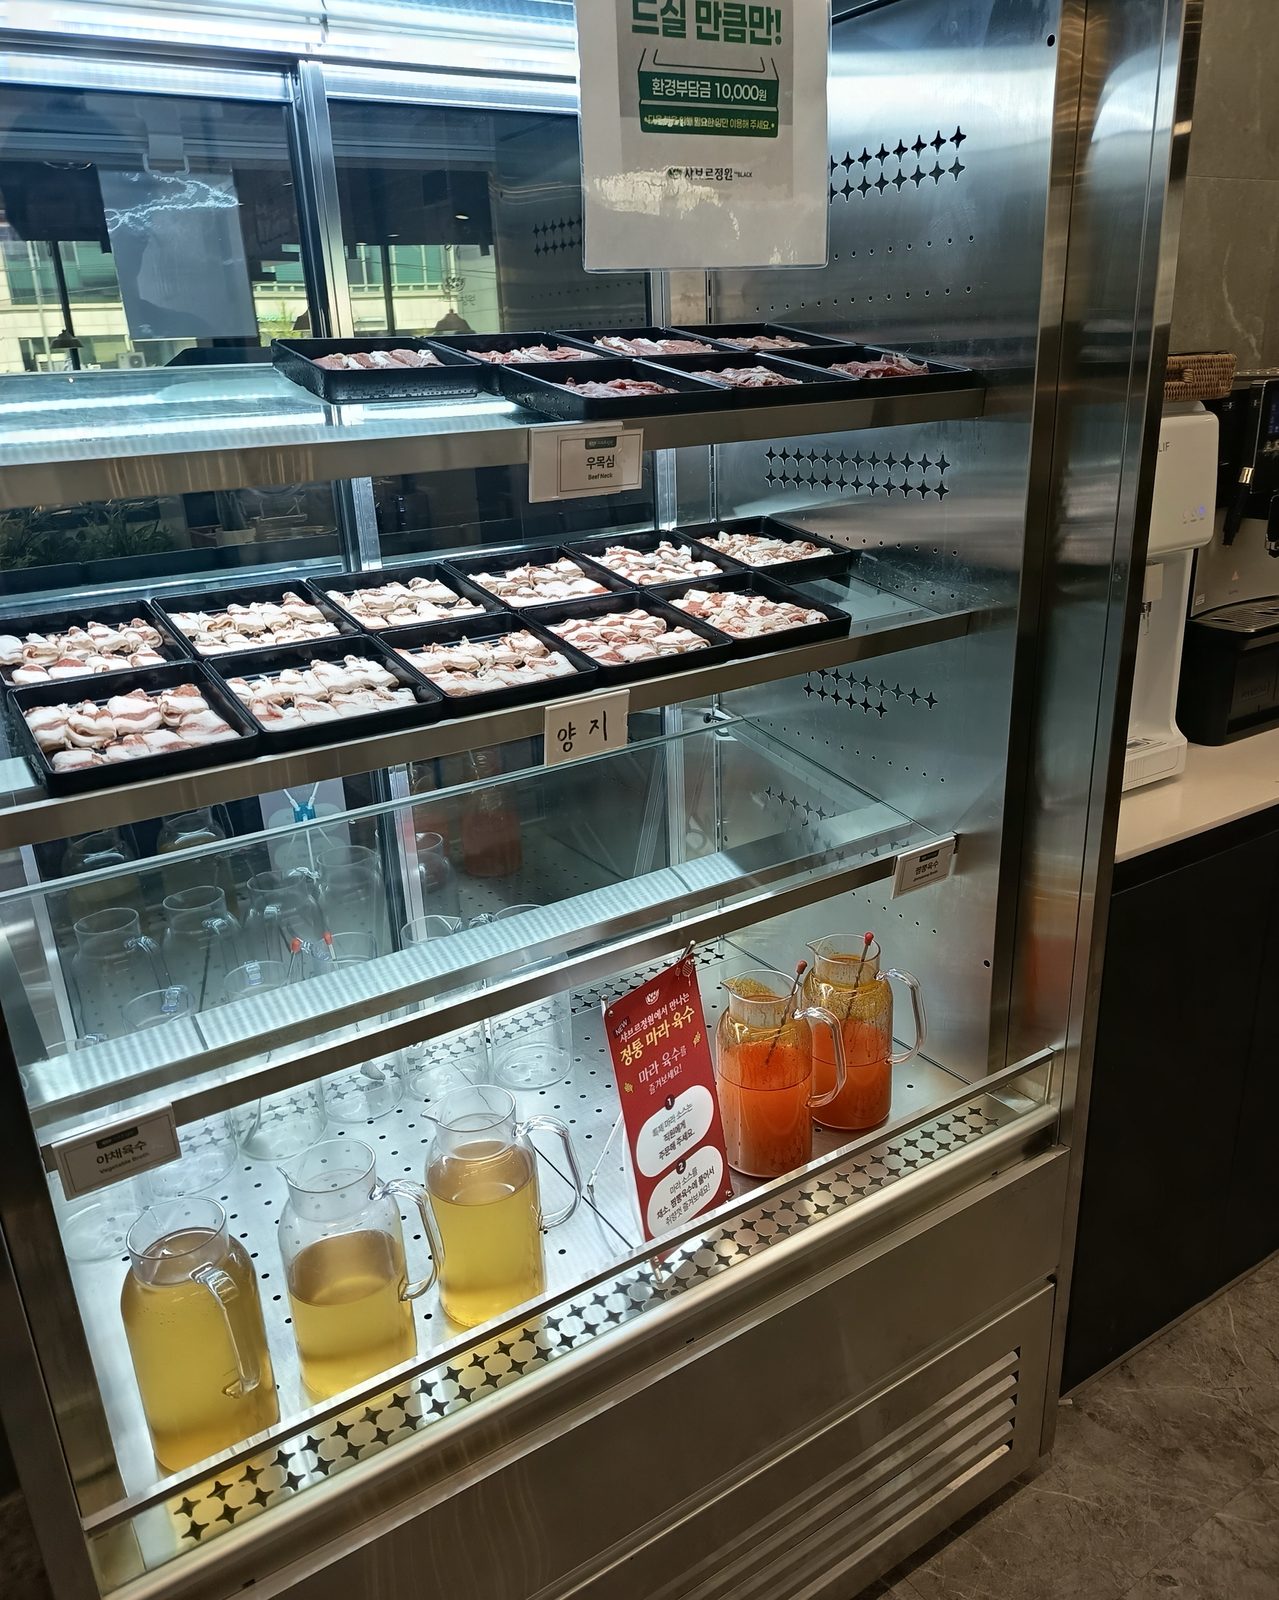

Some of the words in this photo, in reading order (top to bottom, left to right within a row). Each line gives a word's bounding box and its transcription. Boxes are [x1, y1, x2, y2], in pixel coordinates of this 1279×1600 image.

[632, 0, 686, 38] 드실
[696, 1, 781, 45] 만큼만!
[652, 78, 711, 98] 환경부담금
[715, 83, 767, 101] 10,000원
[586, 454, 615, 470] 우목심
[615, 1019, 629, 1036] NEW
[620, 1004, 668, 1042] 샤브르정원에서
[669, 992, 690, 1012] 만나는
[620, 1037, 644, 1066] 정통
[645, 1020, 670, 1046] 마라
[672, 1005, 695, 1029] 육수
[638, 1061, 660, 1083] 마라
[662, 1045, 687, 1068] 육수를
[667, 1097, 672, 1106] 1
[96, 1140, 147, 1165] 야채육수
[680, 1162, 684, 1170] 2
[670, 1180, 682, 1194] 마라
